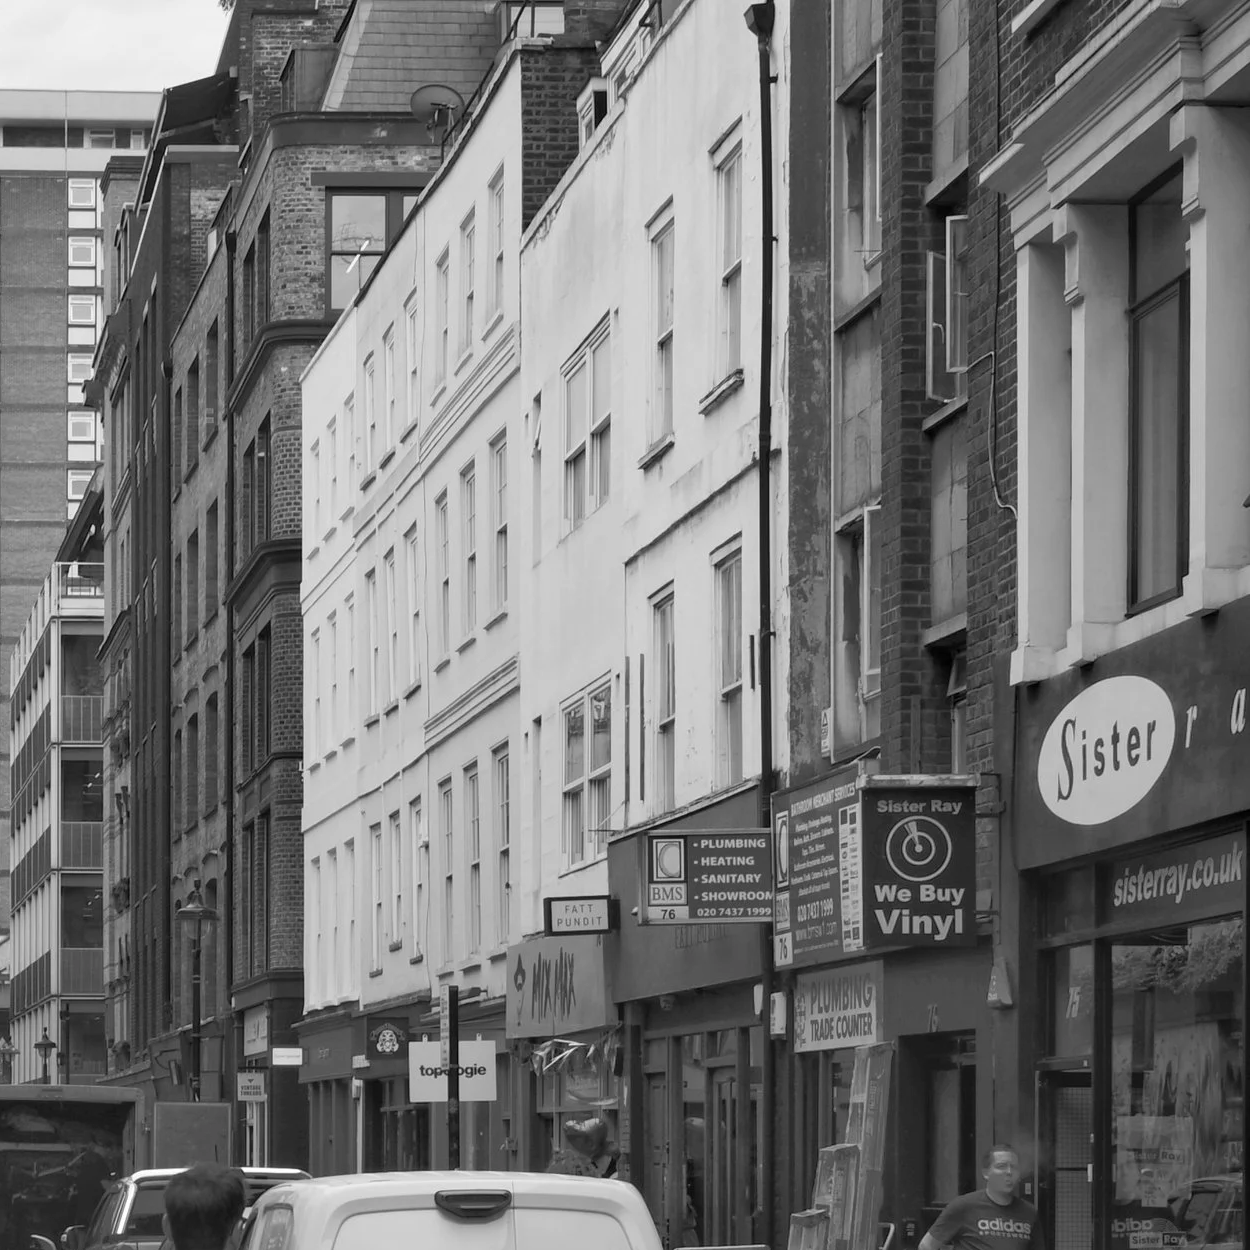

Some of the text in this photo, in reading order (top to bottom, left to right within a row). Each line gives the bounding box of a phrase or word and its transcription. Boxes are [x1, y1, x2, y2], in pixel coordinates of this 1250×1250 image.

[1057, 717, 1157, 803] Sister
[877, 800, 962, 815] Sister Ray
[701, 838, 766, 849] PLUMBING
[701, 856, 755, 866] HEATING
[701, 873, 761, 884] SANITARY
[1113, 841, 1243, 907] sisterray.co.uk
[652, 887, 683, 901] BMS
[874, 884, 966, 906] We Buy
[564, 903, 594, 914] FATT
[660, 908, 676, 920] 76
[697, 906, 772, 917] 020 7437 1999
[557, 917, 603, 927] PUNDIT
[874, 909, 963, 941] Vinyl
[779, 937, 788, 960] 76
[810, 973, 873, 1015] PLUMBING
[810, 1017, 834, 1042] TRADE
[836, 1012, 873, 1039] COUNTER
[420, 1063, 486, 1079] topoogie
[977, 1218, 1031, 1234] adidas
[1131, 1235, 1161, 1245] Sister
[1163, 1234, 1186, 1246] Ray
